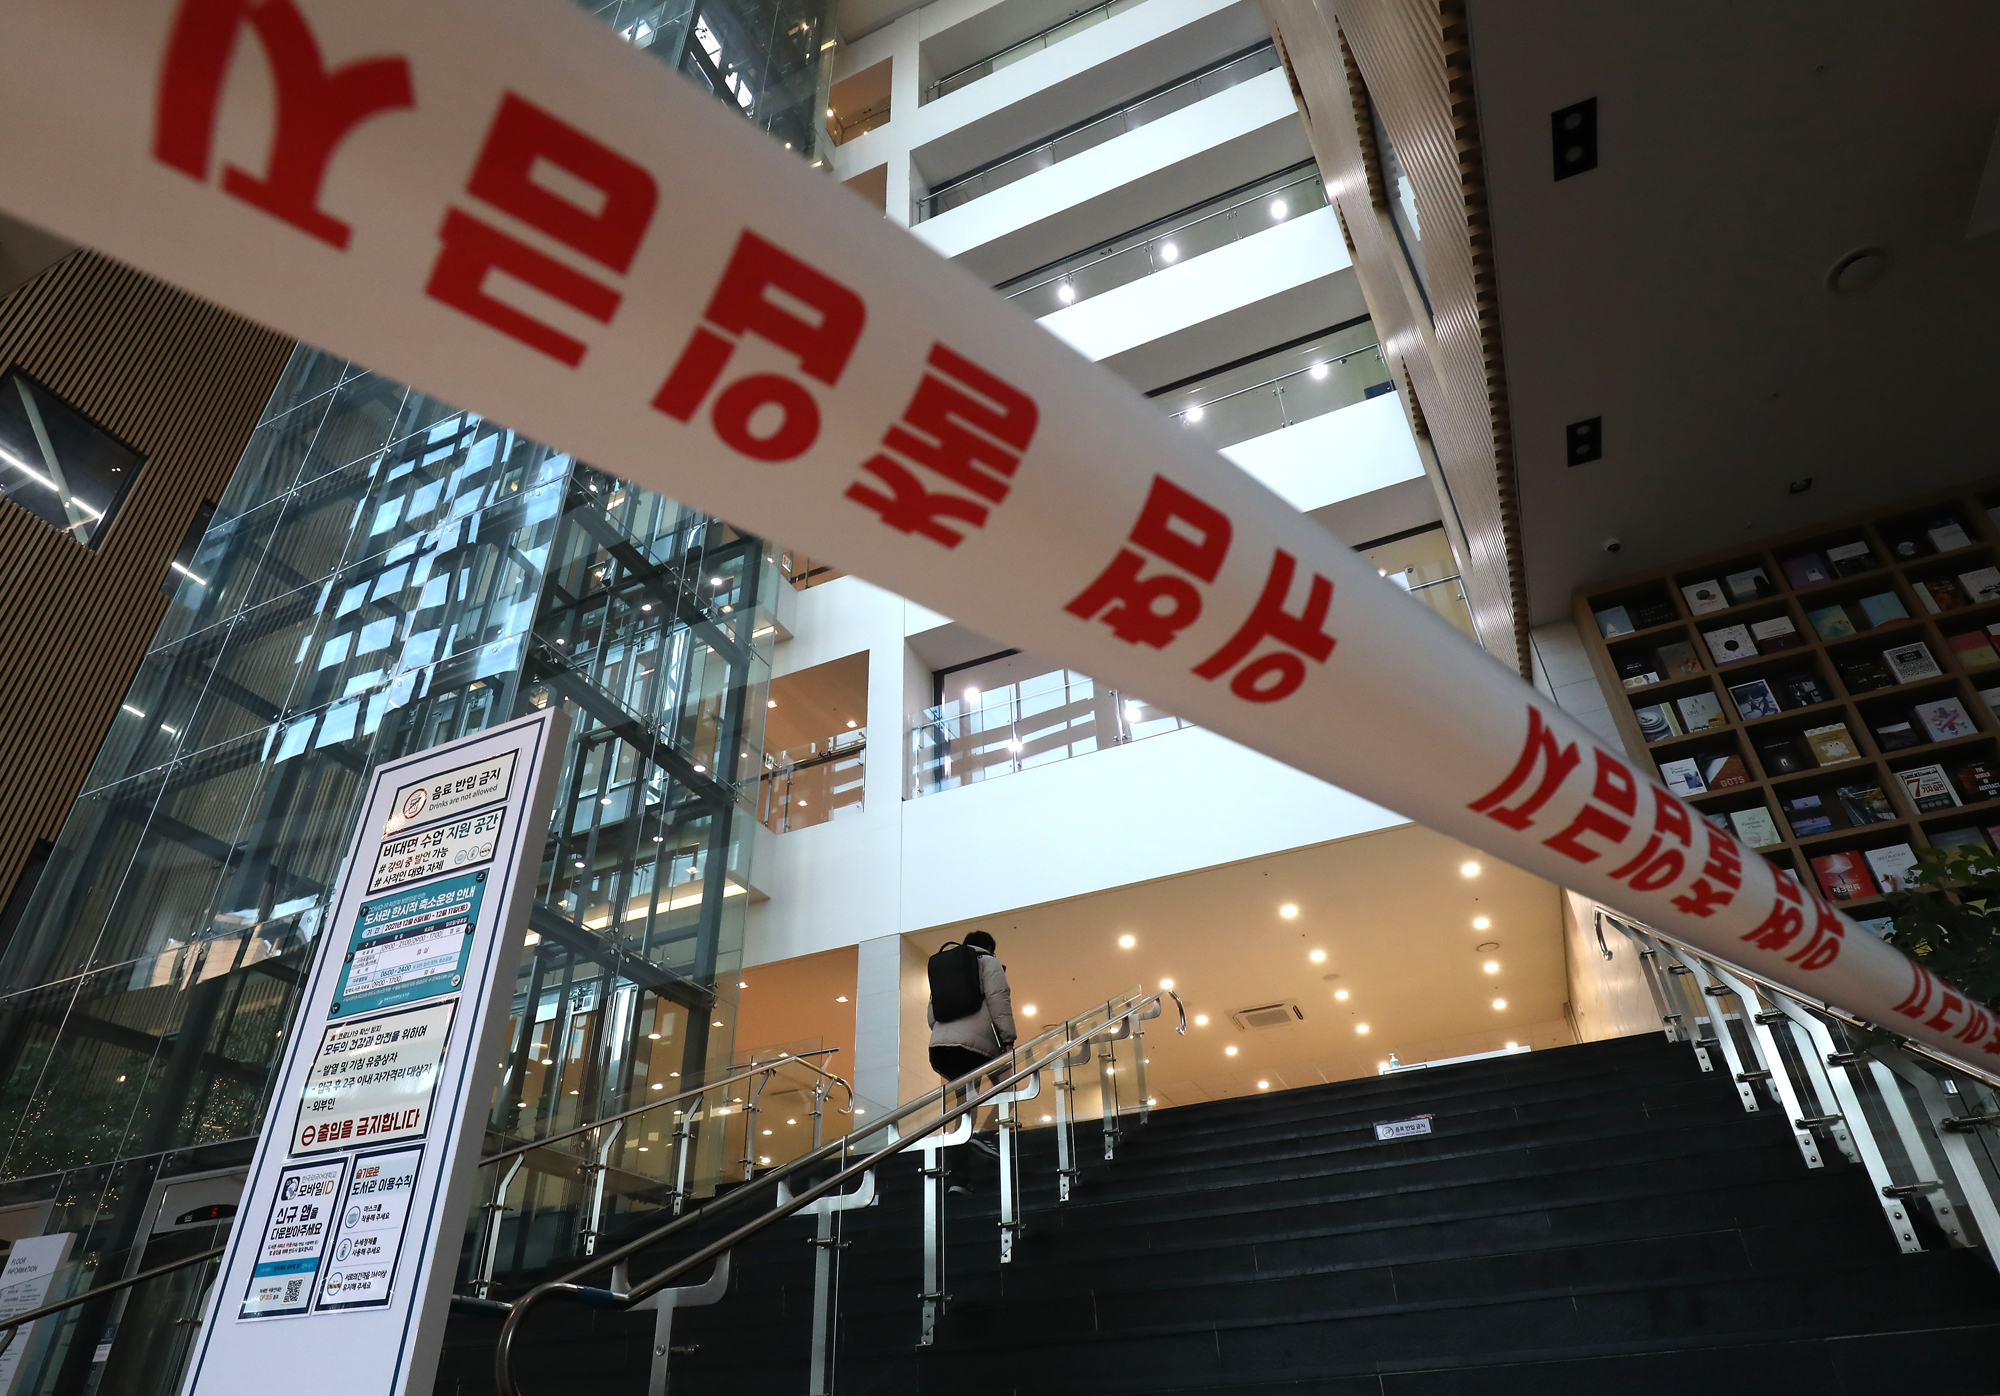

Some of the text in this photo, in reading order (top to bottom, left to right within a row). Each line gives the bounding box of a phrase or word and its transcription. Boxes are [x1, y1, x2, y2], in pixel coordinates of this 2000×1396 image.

[153, 0, 1337, 703] 위험 출입금지
[432, 768, 501, 800] 음료 반입 금지
[1720, 776, 1745, 787] DOTS
[1907, 778, 1921, 797] 7
[429, 800, 448, 811] Drinks
[461, 793, 471, 801] not
[472, 784, 498, 797] allowed
[383, 813, 498, 858] 비대면 수업 지원 공간
[388, 859, 404, 872] 강의
[405, 856, 412, 867] 중
[415, 851, 431, 865] 발언
[432, 847, 448, 858] 가능
[383, 870, 406, 884] 사적인
[408, 865, 425, 877] 대화
[426, 860, 444, 872] 자제
[364, 886, 476, 925] 도서관 한시적 축소운영 안내
[385, 921, 402, 931] 2021년
[403, 918, 413, 926] 12월
[436, 909, 447, 917] 12월
[324, 1025, 427, 1055] 모두의 건강과 안전을 위하여
[323, 1063, 339, 1076] 발열
[340, 1061, 349, 1073] 및
[349, 1058, 365, 1070] 기침
[366, 1052, 398, 1068] 유증상자
[317, 1081, 333, 1094] 입국
[335, 1079, 341, 1090] 후
[343, 1077, 355, 1088] 2주
[357, 1074, 373, 1086] 이내
[373, 1068, 405, 1083] 자가격리
[407, 1063, 432, 1076] 대상자
[312, 1098, 335, 1111] 외부인
[317, 1108, 420, 1142] 출입을 금지합니다
[356, 1166, 380, 1179] 슬기로운
[297, 1180, 334, 1197] 모바일ID
[351, 1175, 412, 1195] 도서관 이용수칙
[211, 1207, 218, 1217] 5
[276, 1204, 318, 1224] 신규 앱을
[364, 1204, 382, 1212] 마스크를
[376, 1212, 390, 1220] 주세요
[366, 1247, 380, 1255] 주세요
[7, 1265, 38, 1275] INFORMATION
[11, 1257, 26, 1266] FLOOR
[357, 1282, 371, 1290] 주세요
